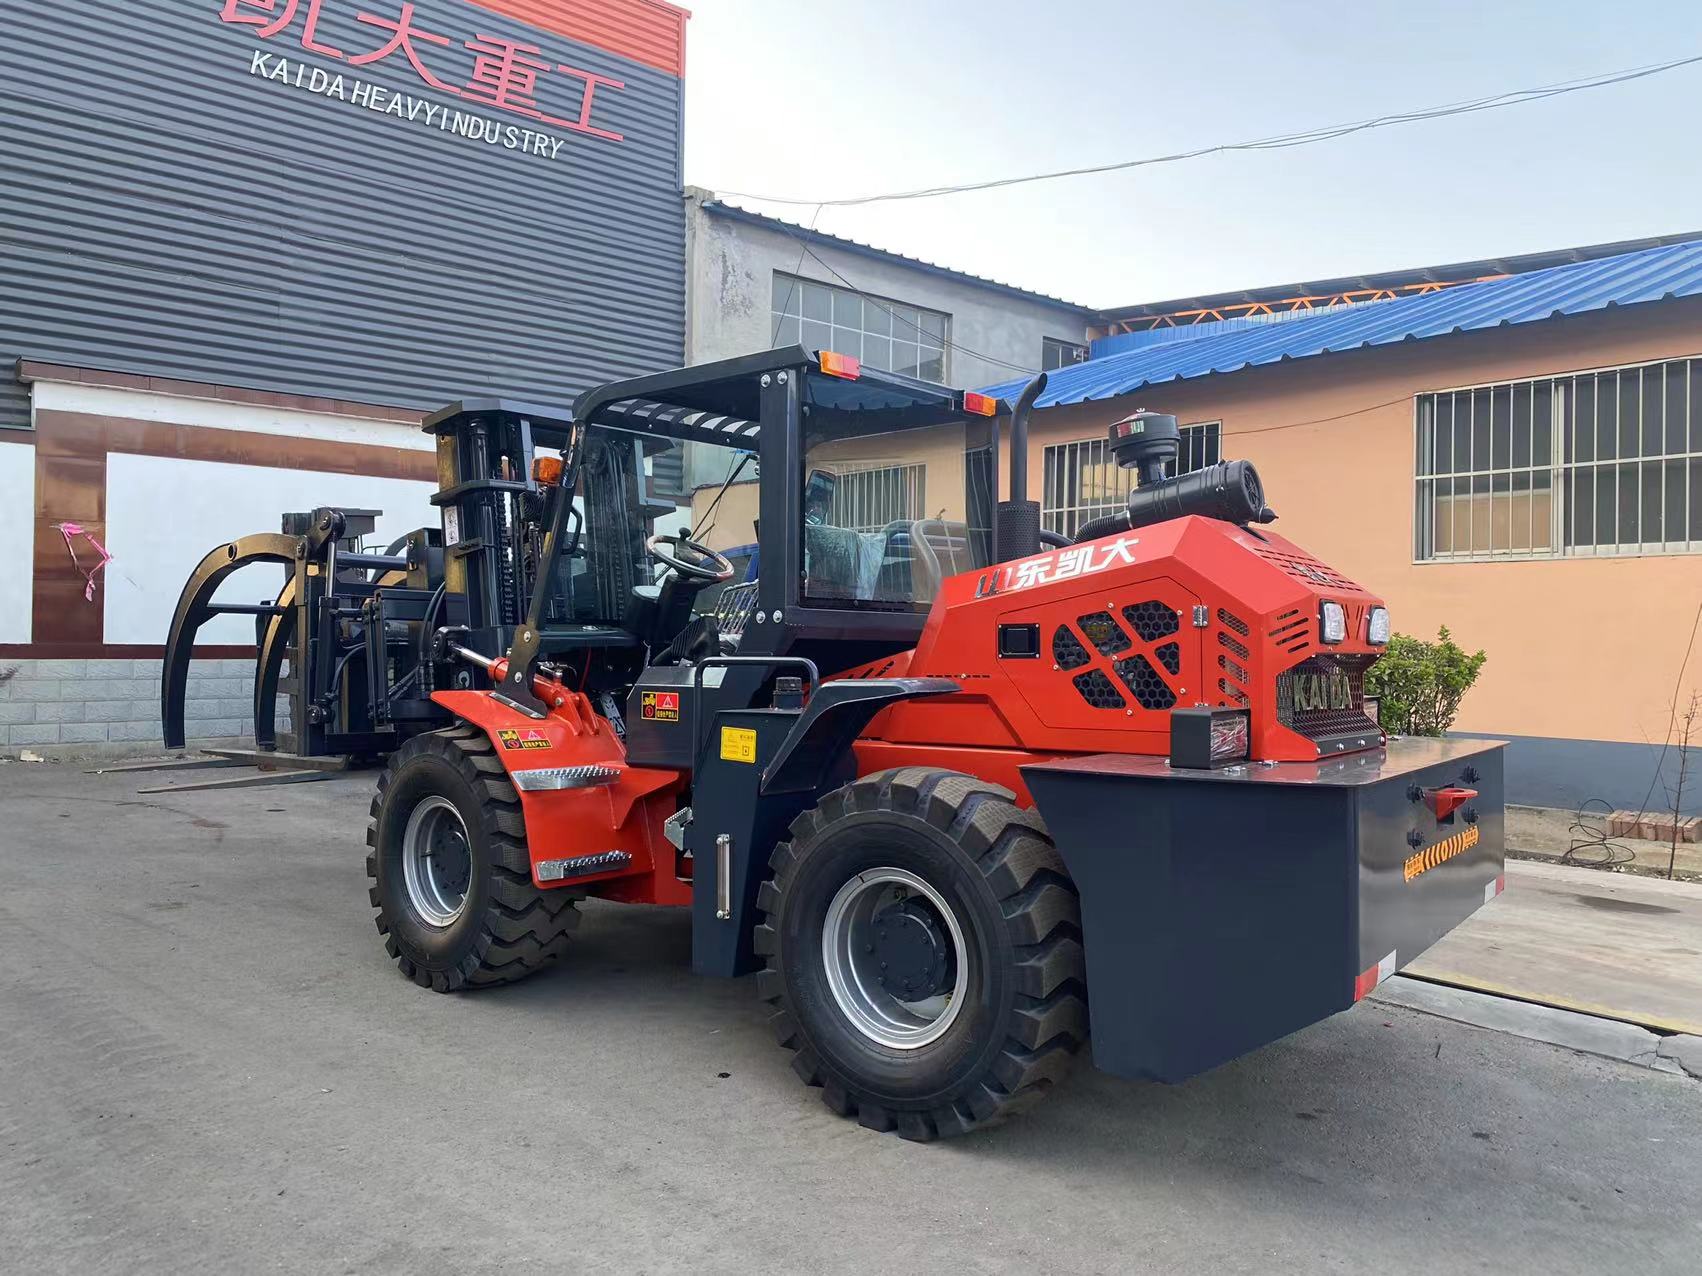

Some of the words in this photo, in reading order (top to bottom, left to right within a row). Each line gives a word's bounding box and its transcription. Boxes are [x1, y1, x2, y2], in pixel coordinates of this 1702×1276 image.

[250, 50, 345, 101] KAIDA
[975, 538, 1139, 598] 山东凯大
[1292, 673, 1353, 712] KAIDA
